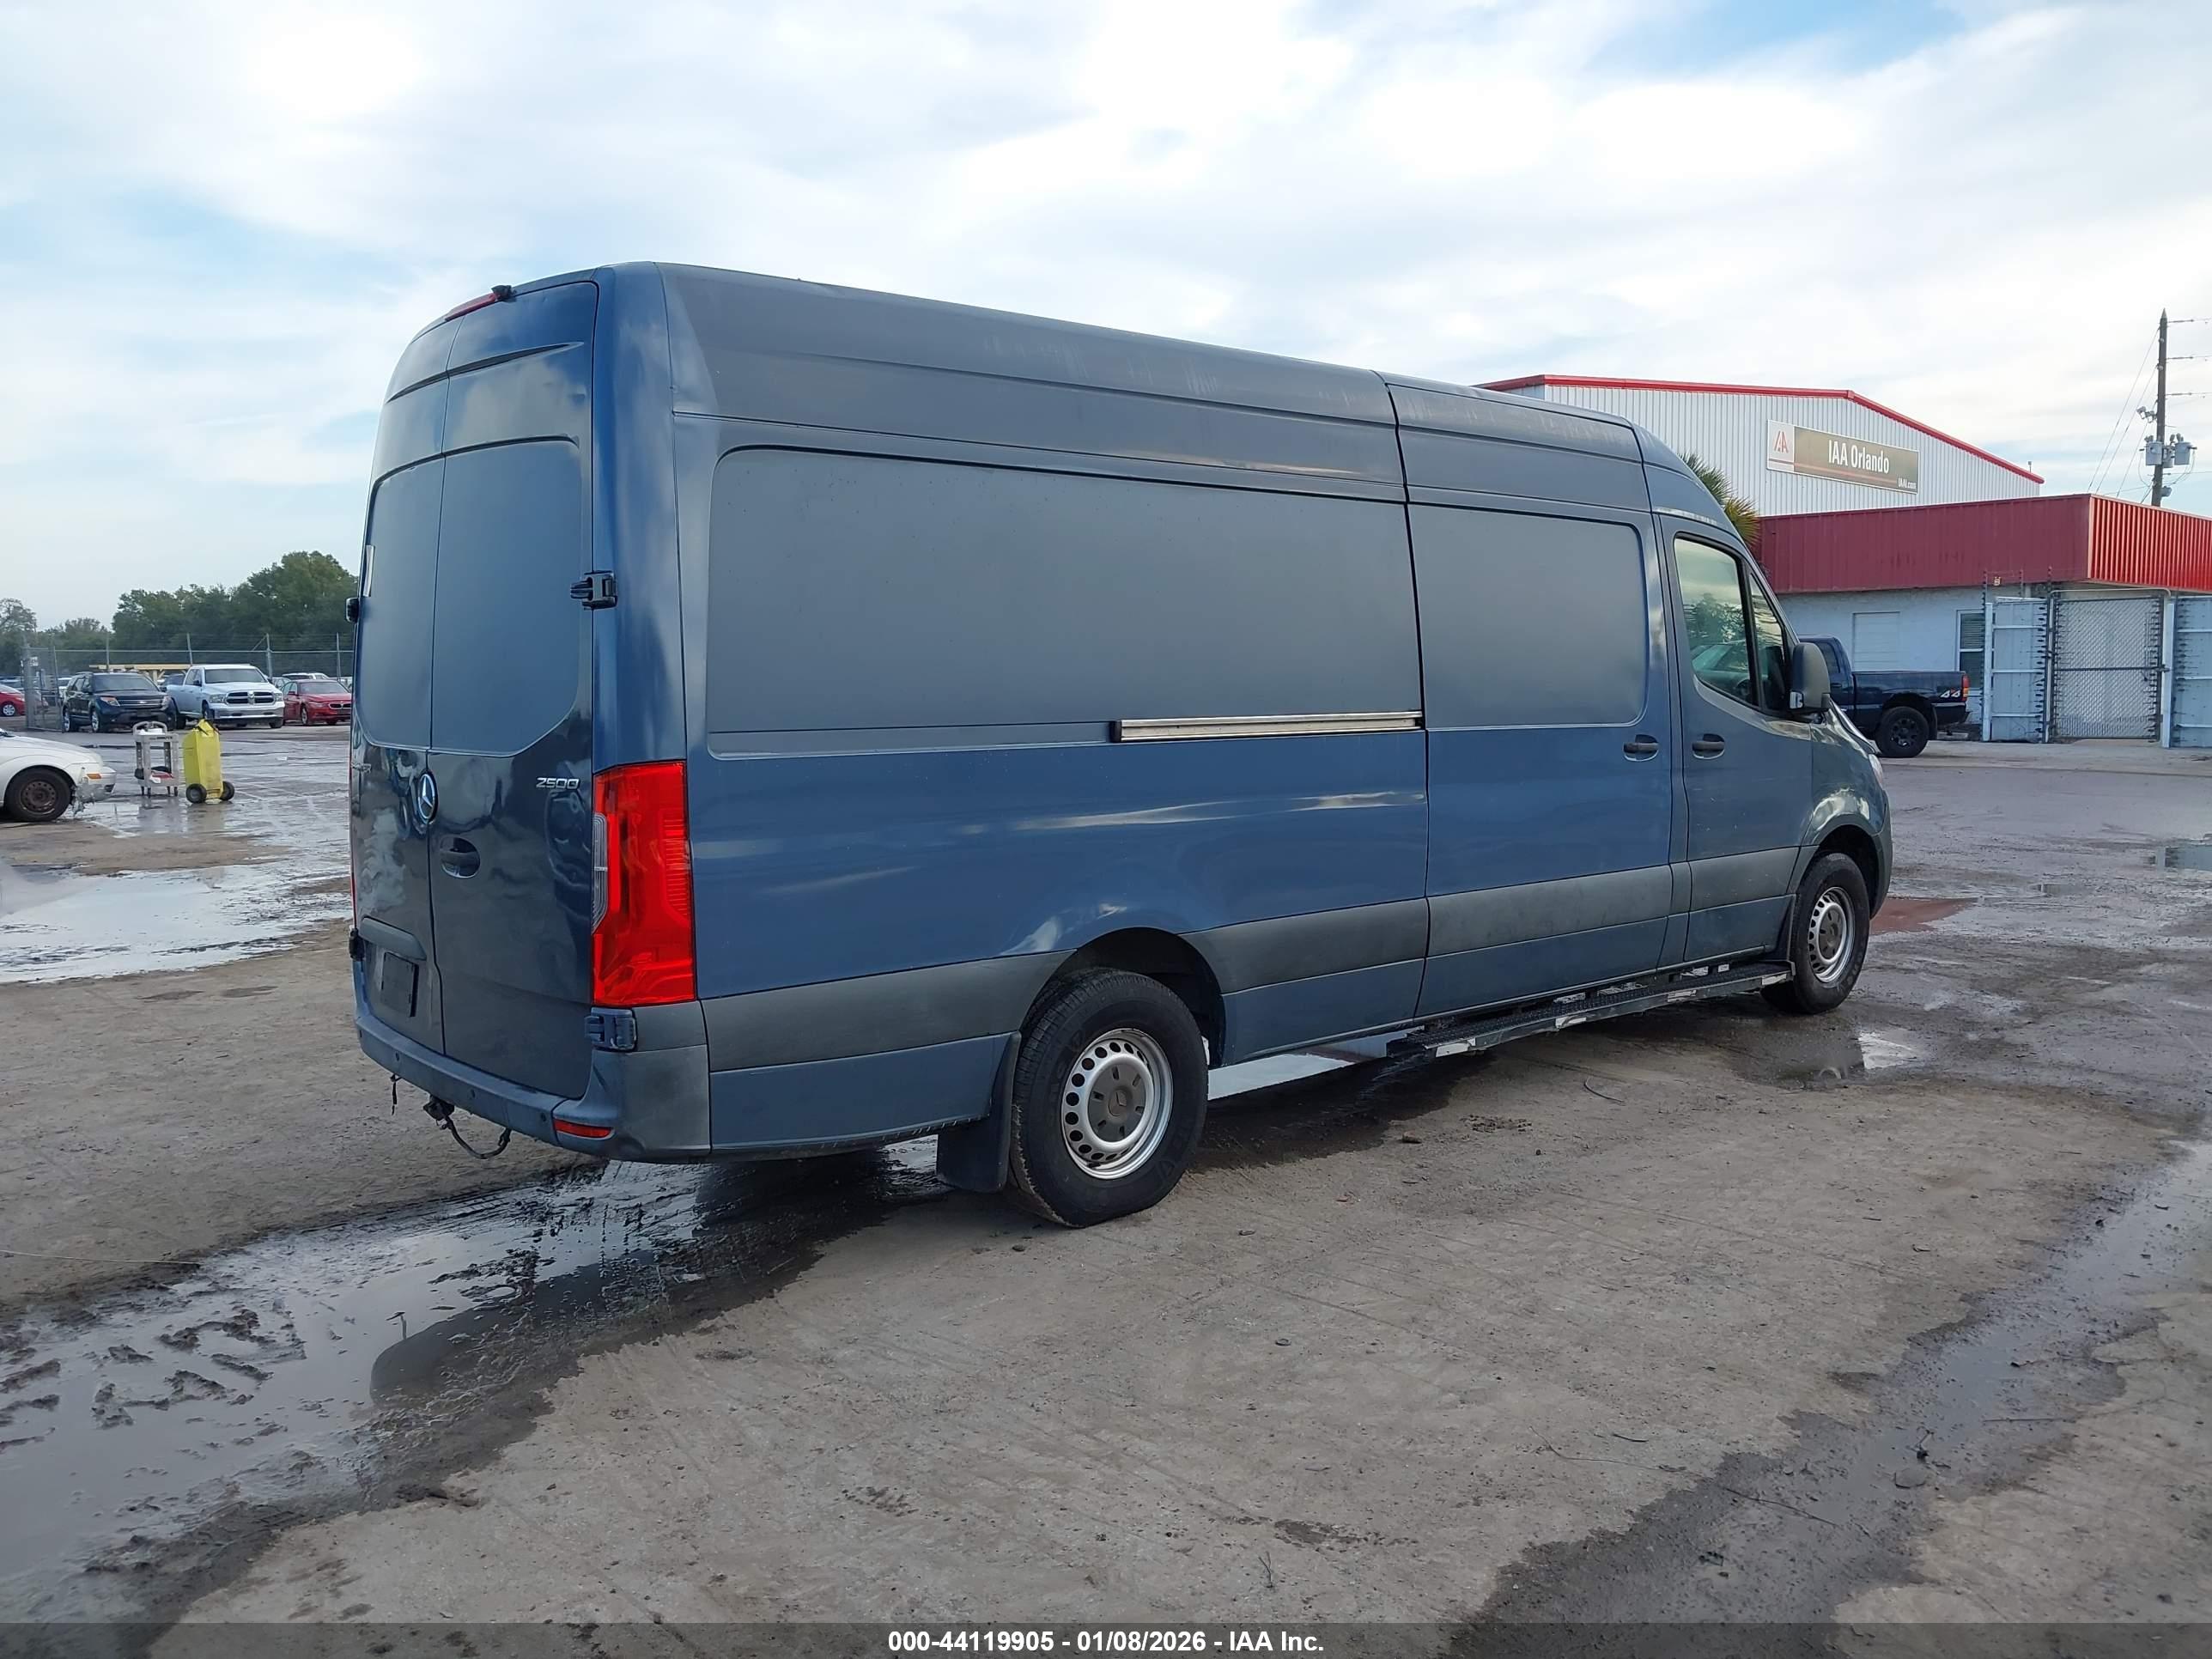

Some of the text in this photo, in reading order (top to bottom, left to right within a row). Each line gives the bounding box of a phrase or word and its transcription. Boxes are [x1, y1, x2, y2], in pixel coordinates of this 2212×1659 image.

[1828, 439, 1890, 474] IAA Orlando
[536, 777, 580, 789] 2500
